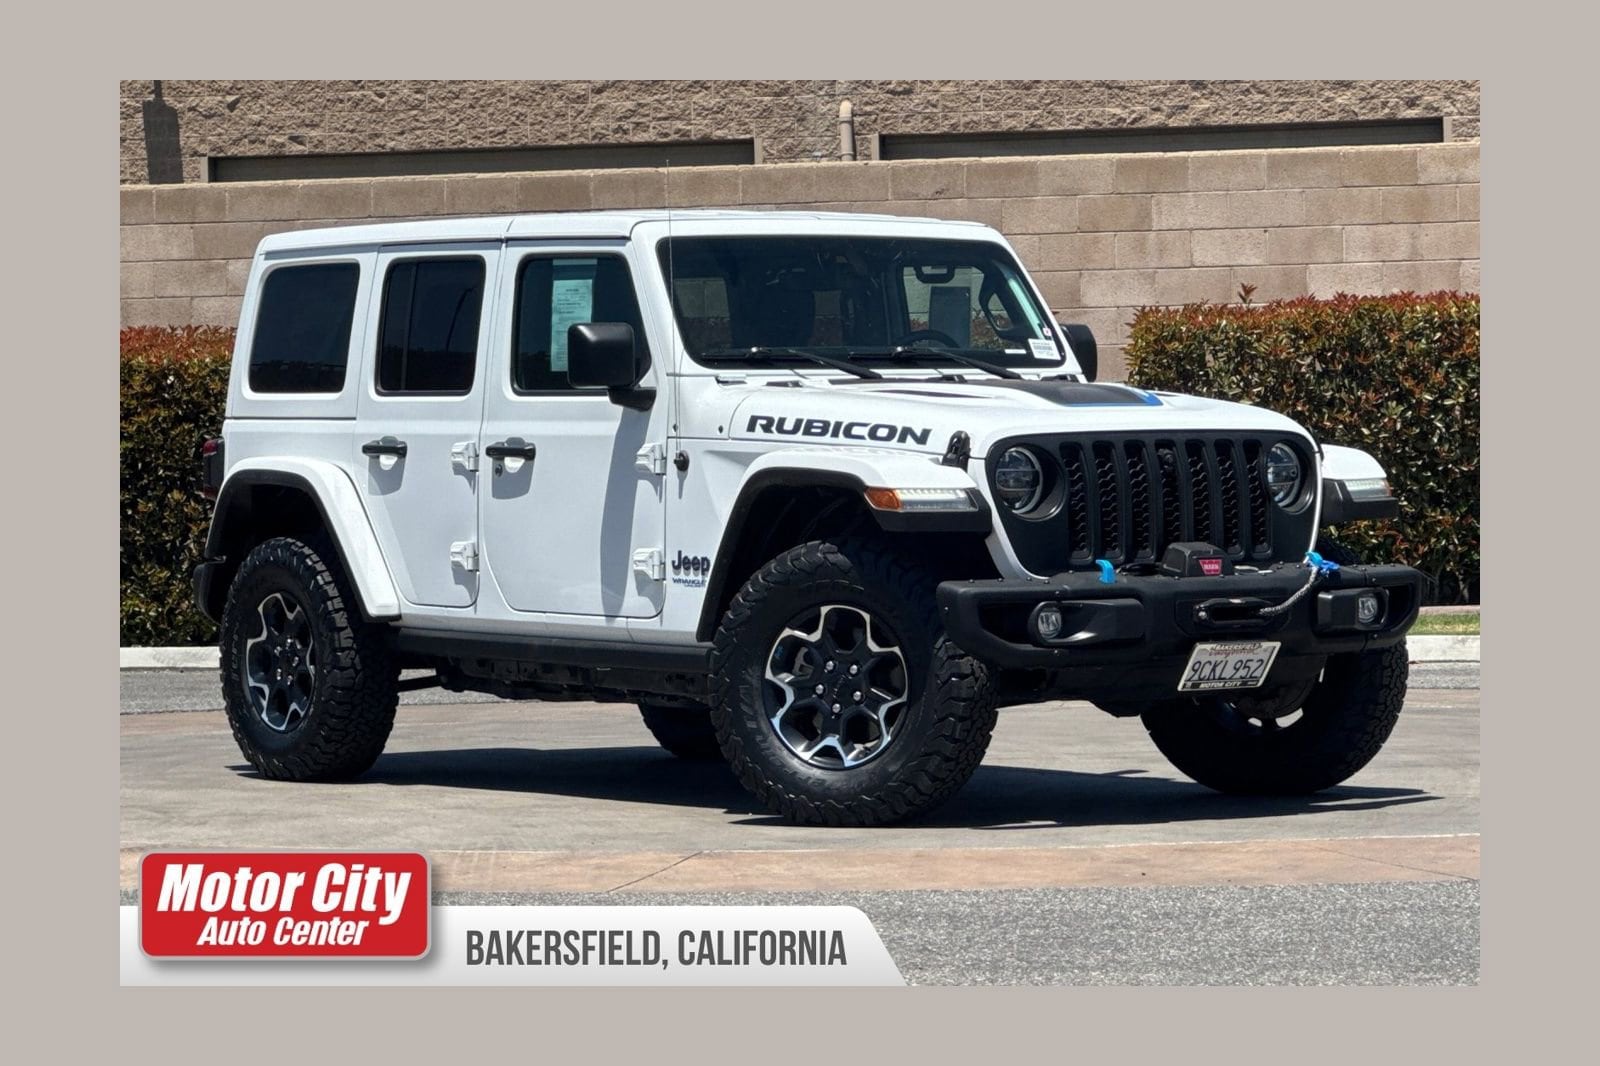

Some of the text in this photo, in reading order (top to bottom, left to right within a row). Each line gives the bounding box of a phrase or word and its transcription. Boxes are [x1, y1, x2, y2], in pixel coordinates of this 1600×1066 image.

[746, 414, 932, 446] RUBICON
[671, 550, 711, 576] Jeep
[1188, 659, 1264, 681] 9CKL952
[1199, 681, 1224, 689] MOTOR
